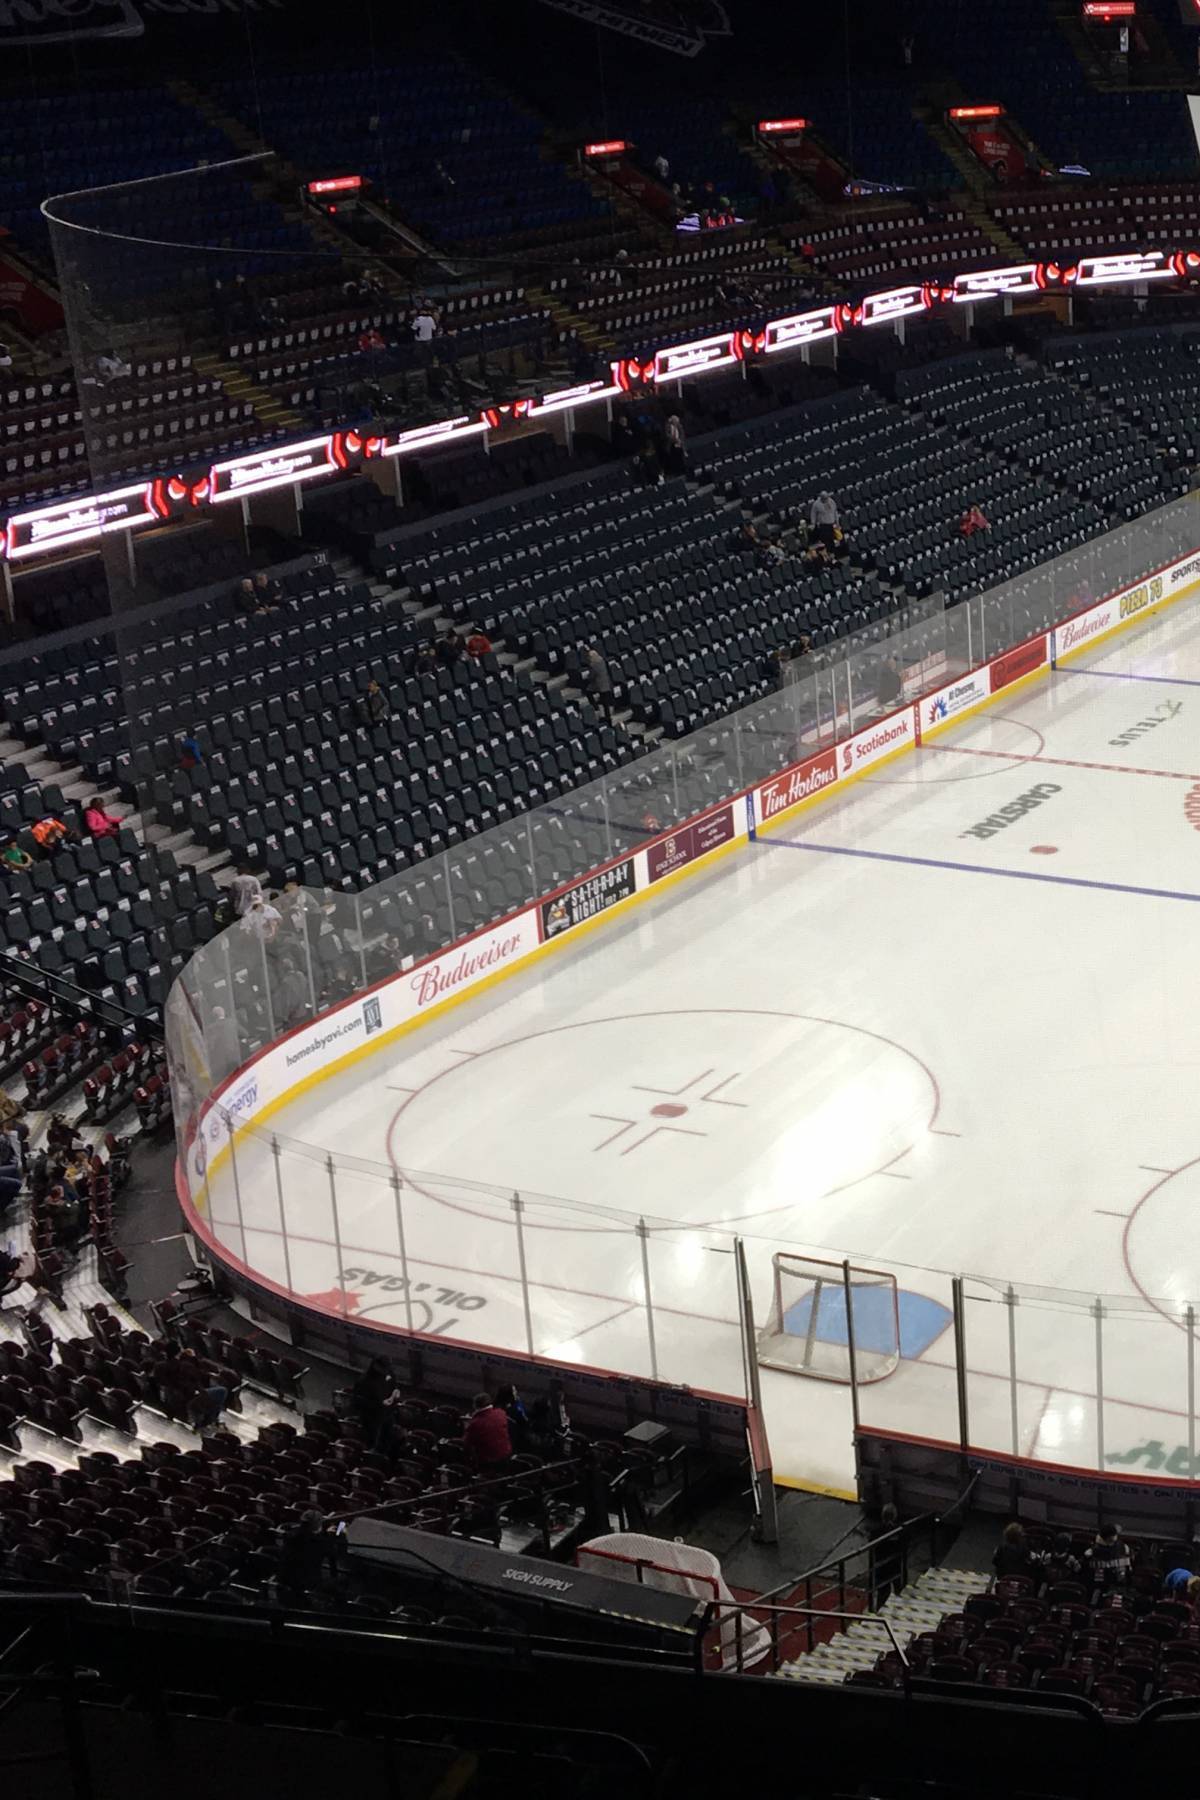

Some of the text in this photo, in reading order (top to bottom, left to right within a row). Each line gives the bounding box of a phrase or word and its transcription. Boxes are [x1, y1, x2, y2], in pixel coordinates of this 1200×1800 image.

[1061, 613, 1110, 649] Budweiser
[856, 720, 909, 758] Scotiabank
[1108, 715, 1167, 748] TELUS
[763, 784, 787, 817] Tim
[789, 766, 836, 803] Hortons
[572, 892, 604, 924] NIGHT!
[411, 934, 520, 1006] Budweiser
[286, 1017, 362, 1068] homesbyavi.com
[336, 1267, 410, 1291] GAS
[433, 1287, 487, 1311] OIL
[502, 1568, 574, 1592] SIGN SUPPLY
